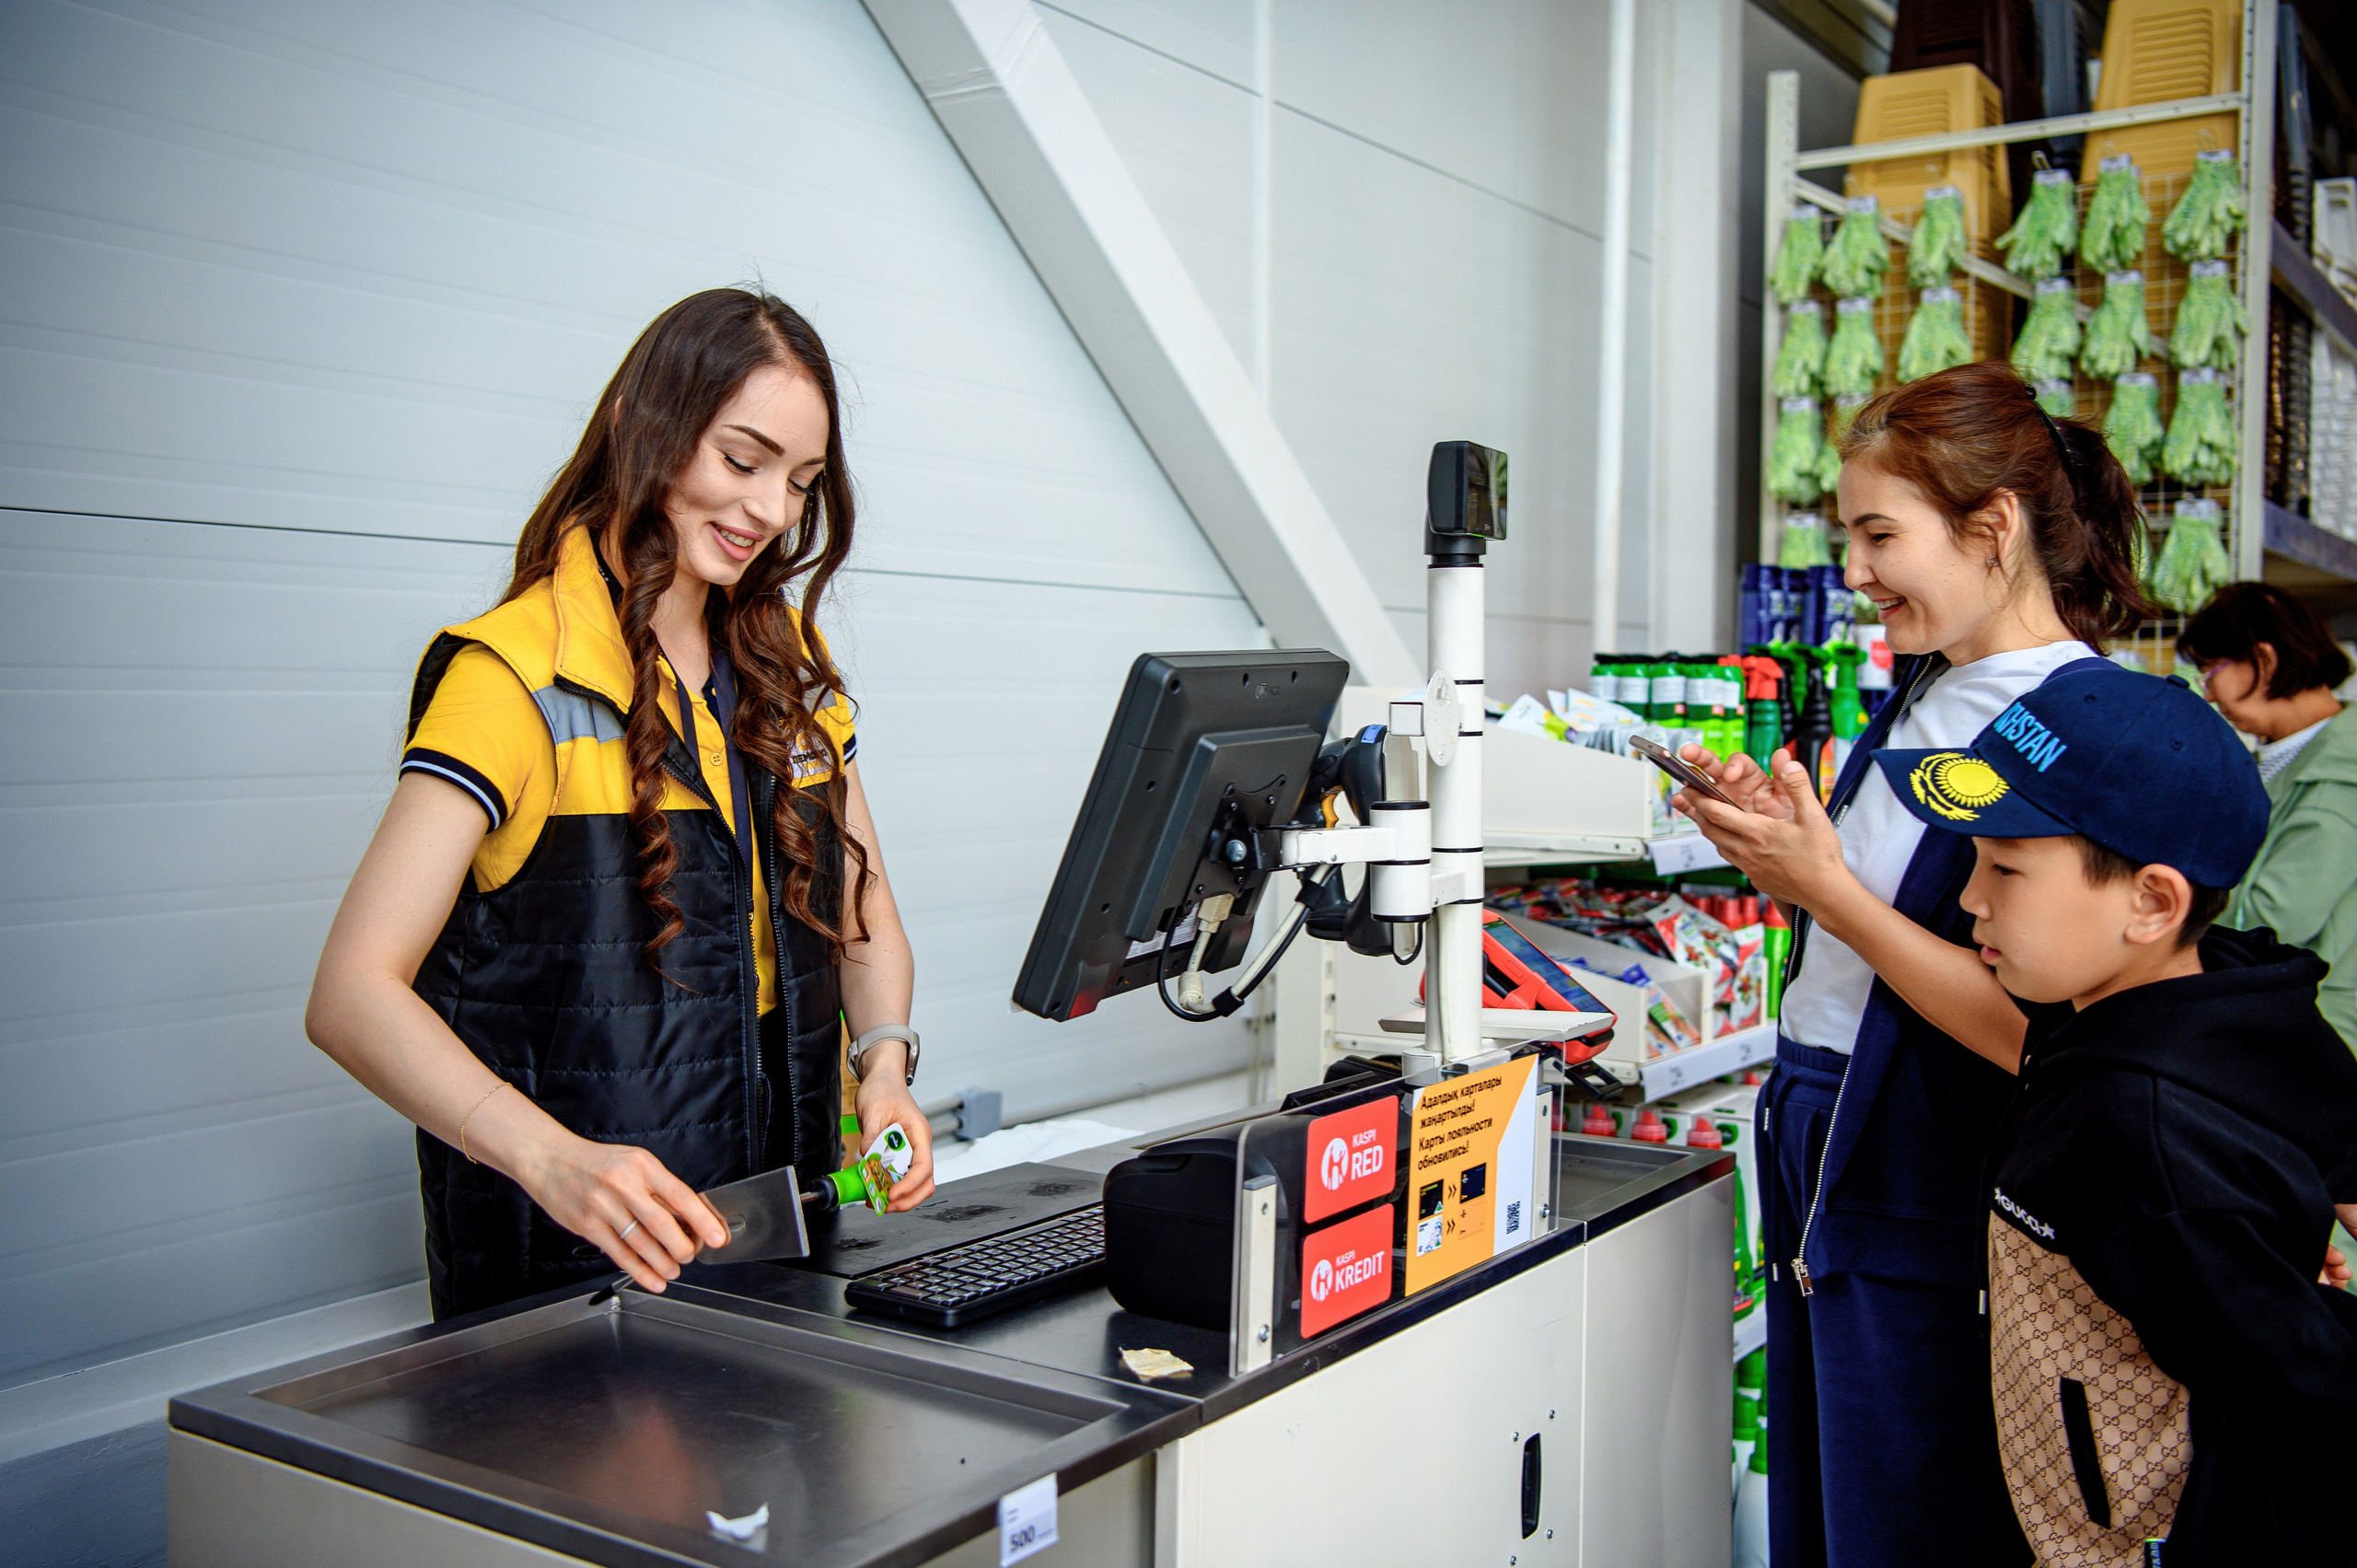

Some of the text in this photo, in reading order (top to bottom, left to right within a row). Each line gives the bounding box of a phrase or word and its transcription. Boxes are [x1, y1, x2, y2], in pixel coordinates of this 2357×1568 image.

[1421, 1076, 1502, 1110] Адалдық карталары
[1420, 1098, 1475, 1129] жаңартылды!
[1353, 1129, 1376, 1147] KASPI
[1419, 1118, 1492, 1152] Карты лояльности
[1352, 1144, 1383, 1180] RED
[1418, 1140, 1469, 1170] обновились!
[1335, 1250, 1385, 1293] KREDIT
[1336, 1250, 1355, 1267] KASPI
